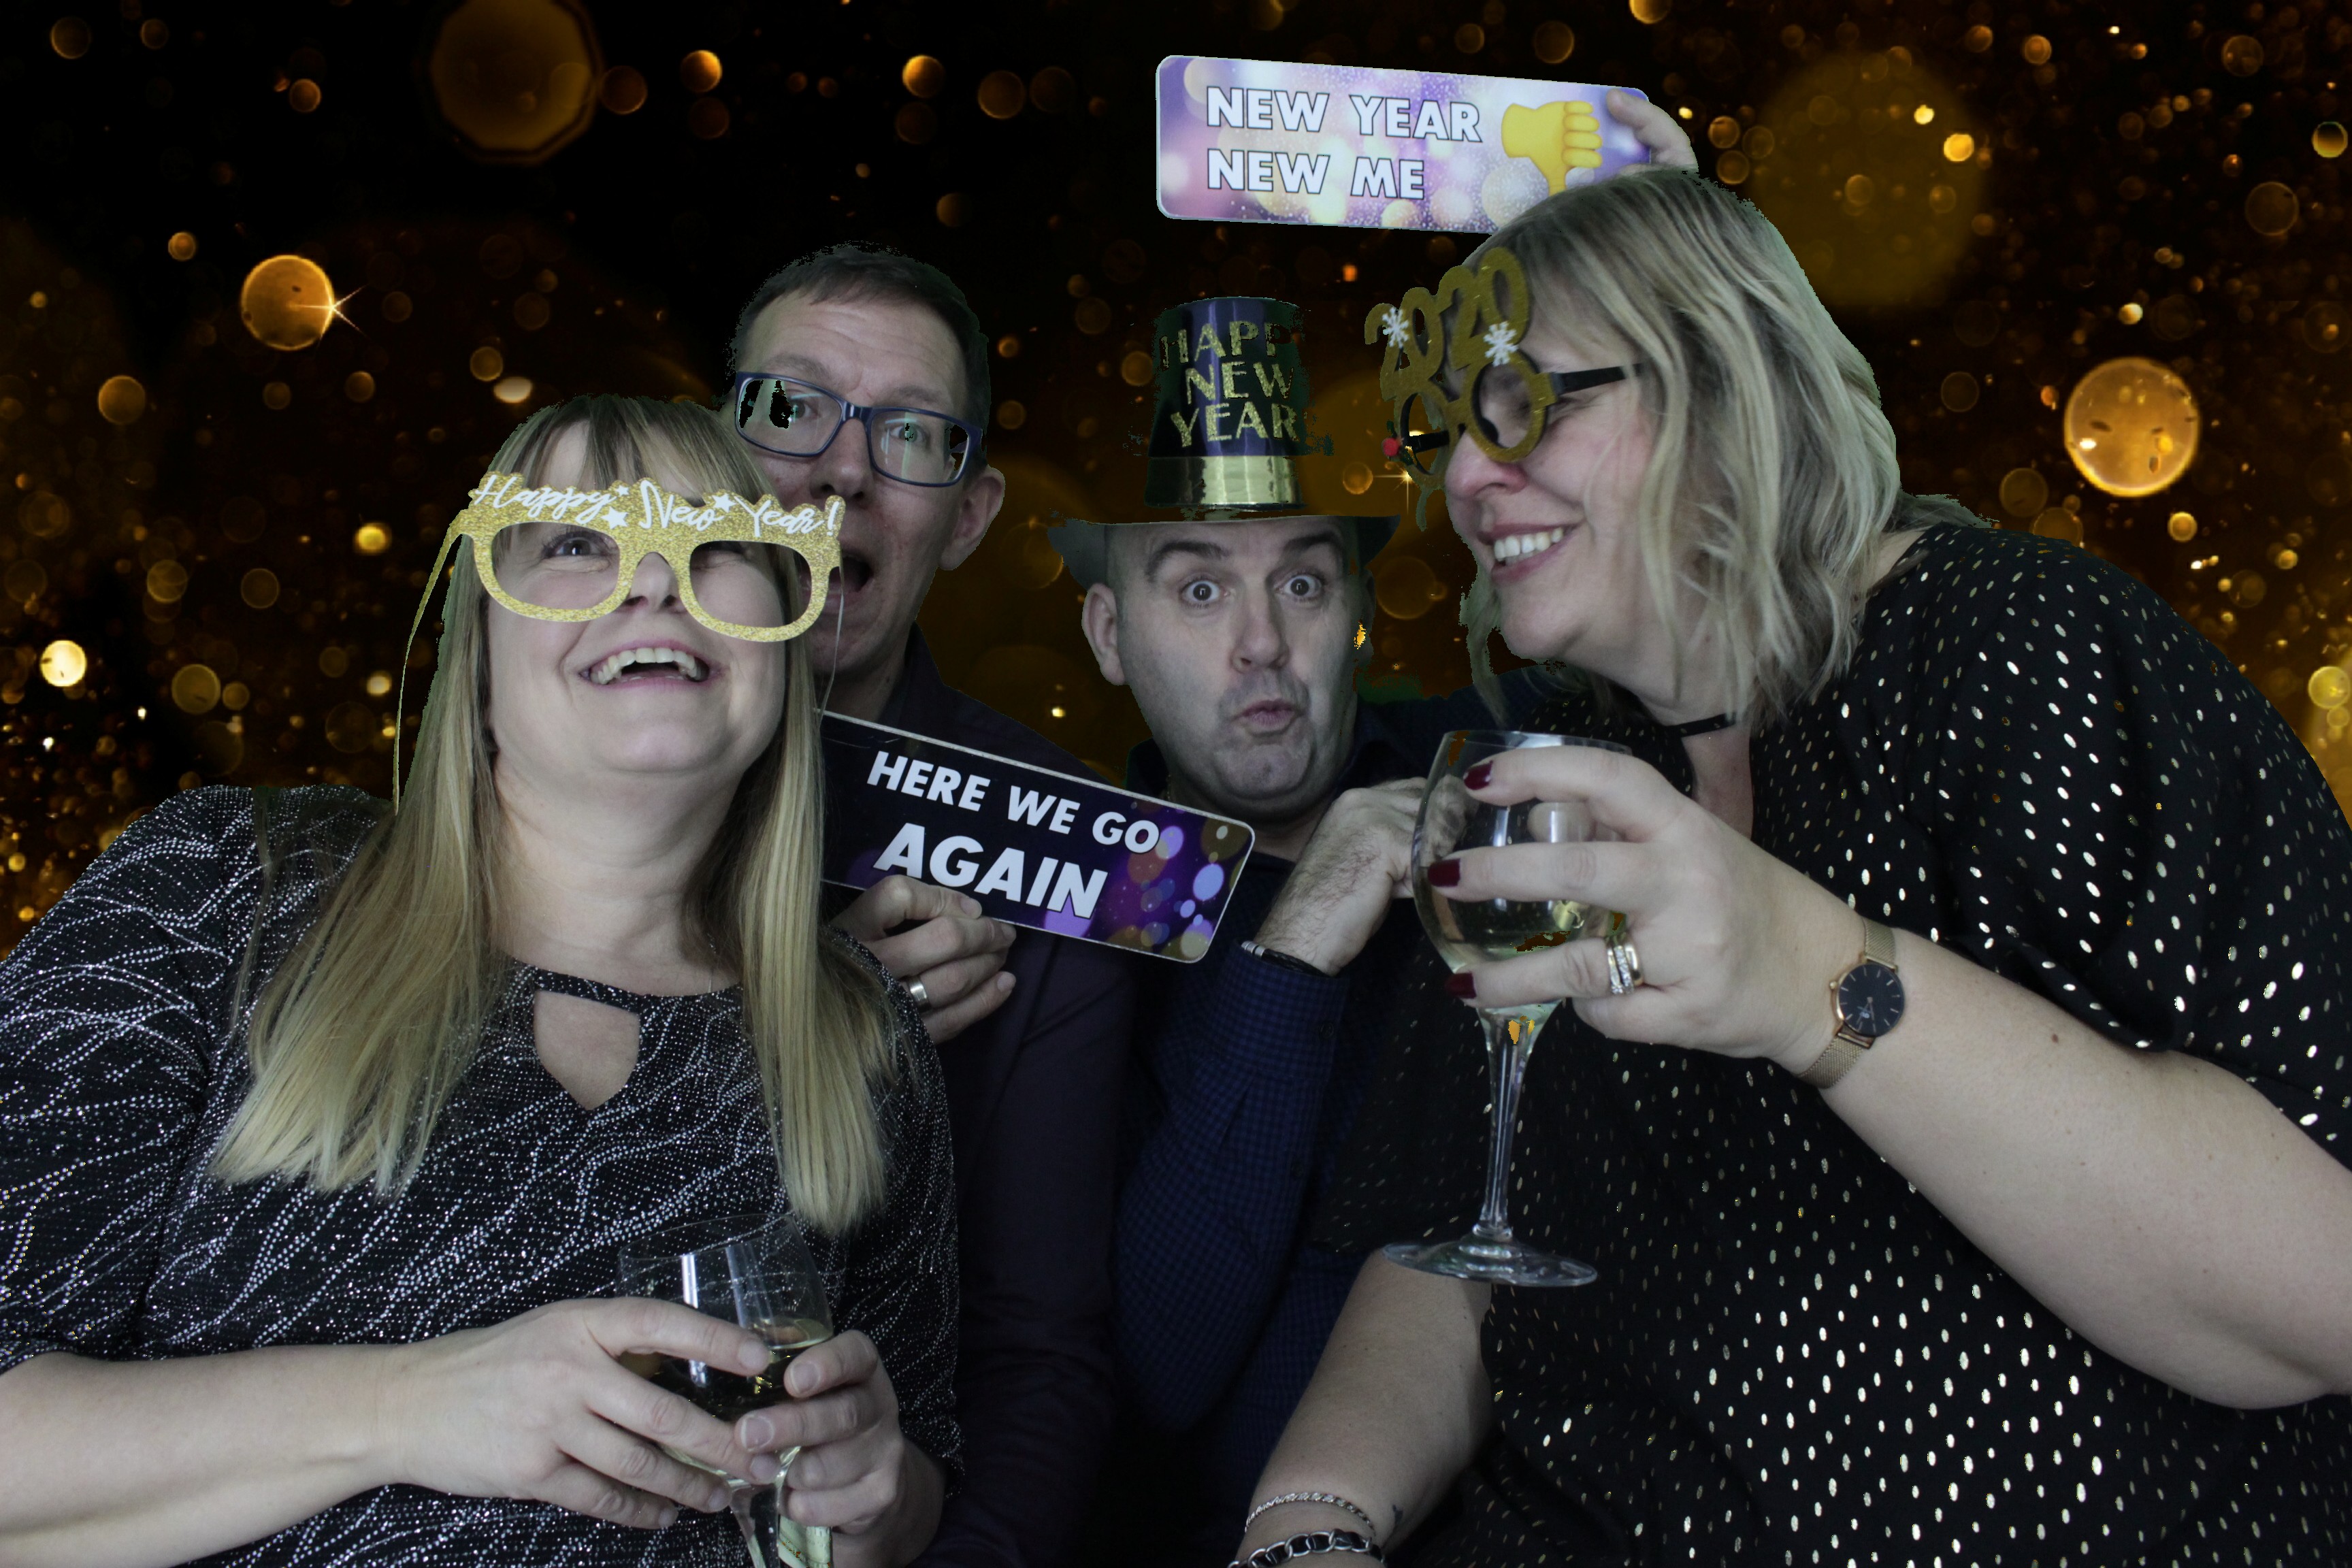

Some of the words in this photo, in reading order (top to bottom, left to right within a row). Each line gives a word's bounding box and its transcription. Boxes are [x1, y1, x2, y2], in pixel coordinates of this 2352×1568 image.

[1207, 86, 1330, 132] NEW
[1350, 95, 1482, 143] YEAR
[1207, 149, 1330, 194] NEW
[1351, 157, 1425, 199] ME
[1160, 321, 1292, 369] HAPP
[1364, 247, 1529, 401] 2020
[1186, 361, 1293, 405] NEW
[1171, 402, 1297, 447] YEAR
[475, 474, 617, 523] Happy
[638, 480, 723, 531] New
[734, 495, 839, 538] Year!
[867, 751, 990, 811] HERE
[1008, 786, 1081, 834] WE
[1093, 812, 1160, 853] GO
[873, 823, 1108, 919] AGAIN
